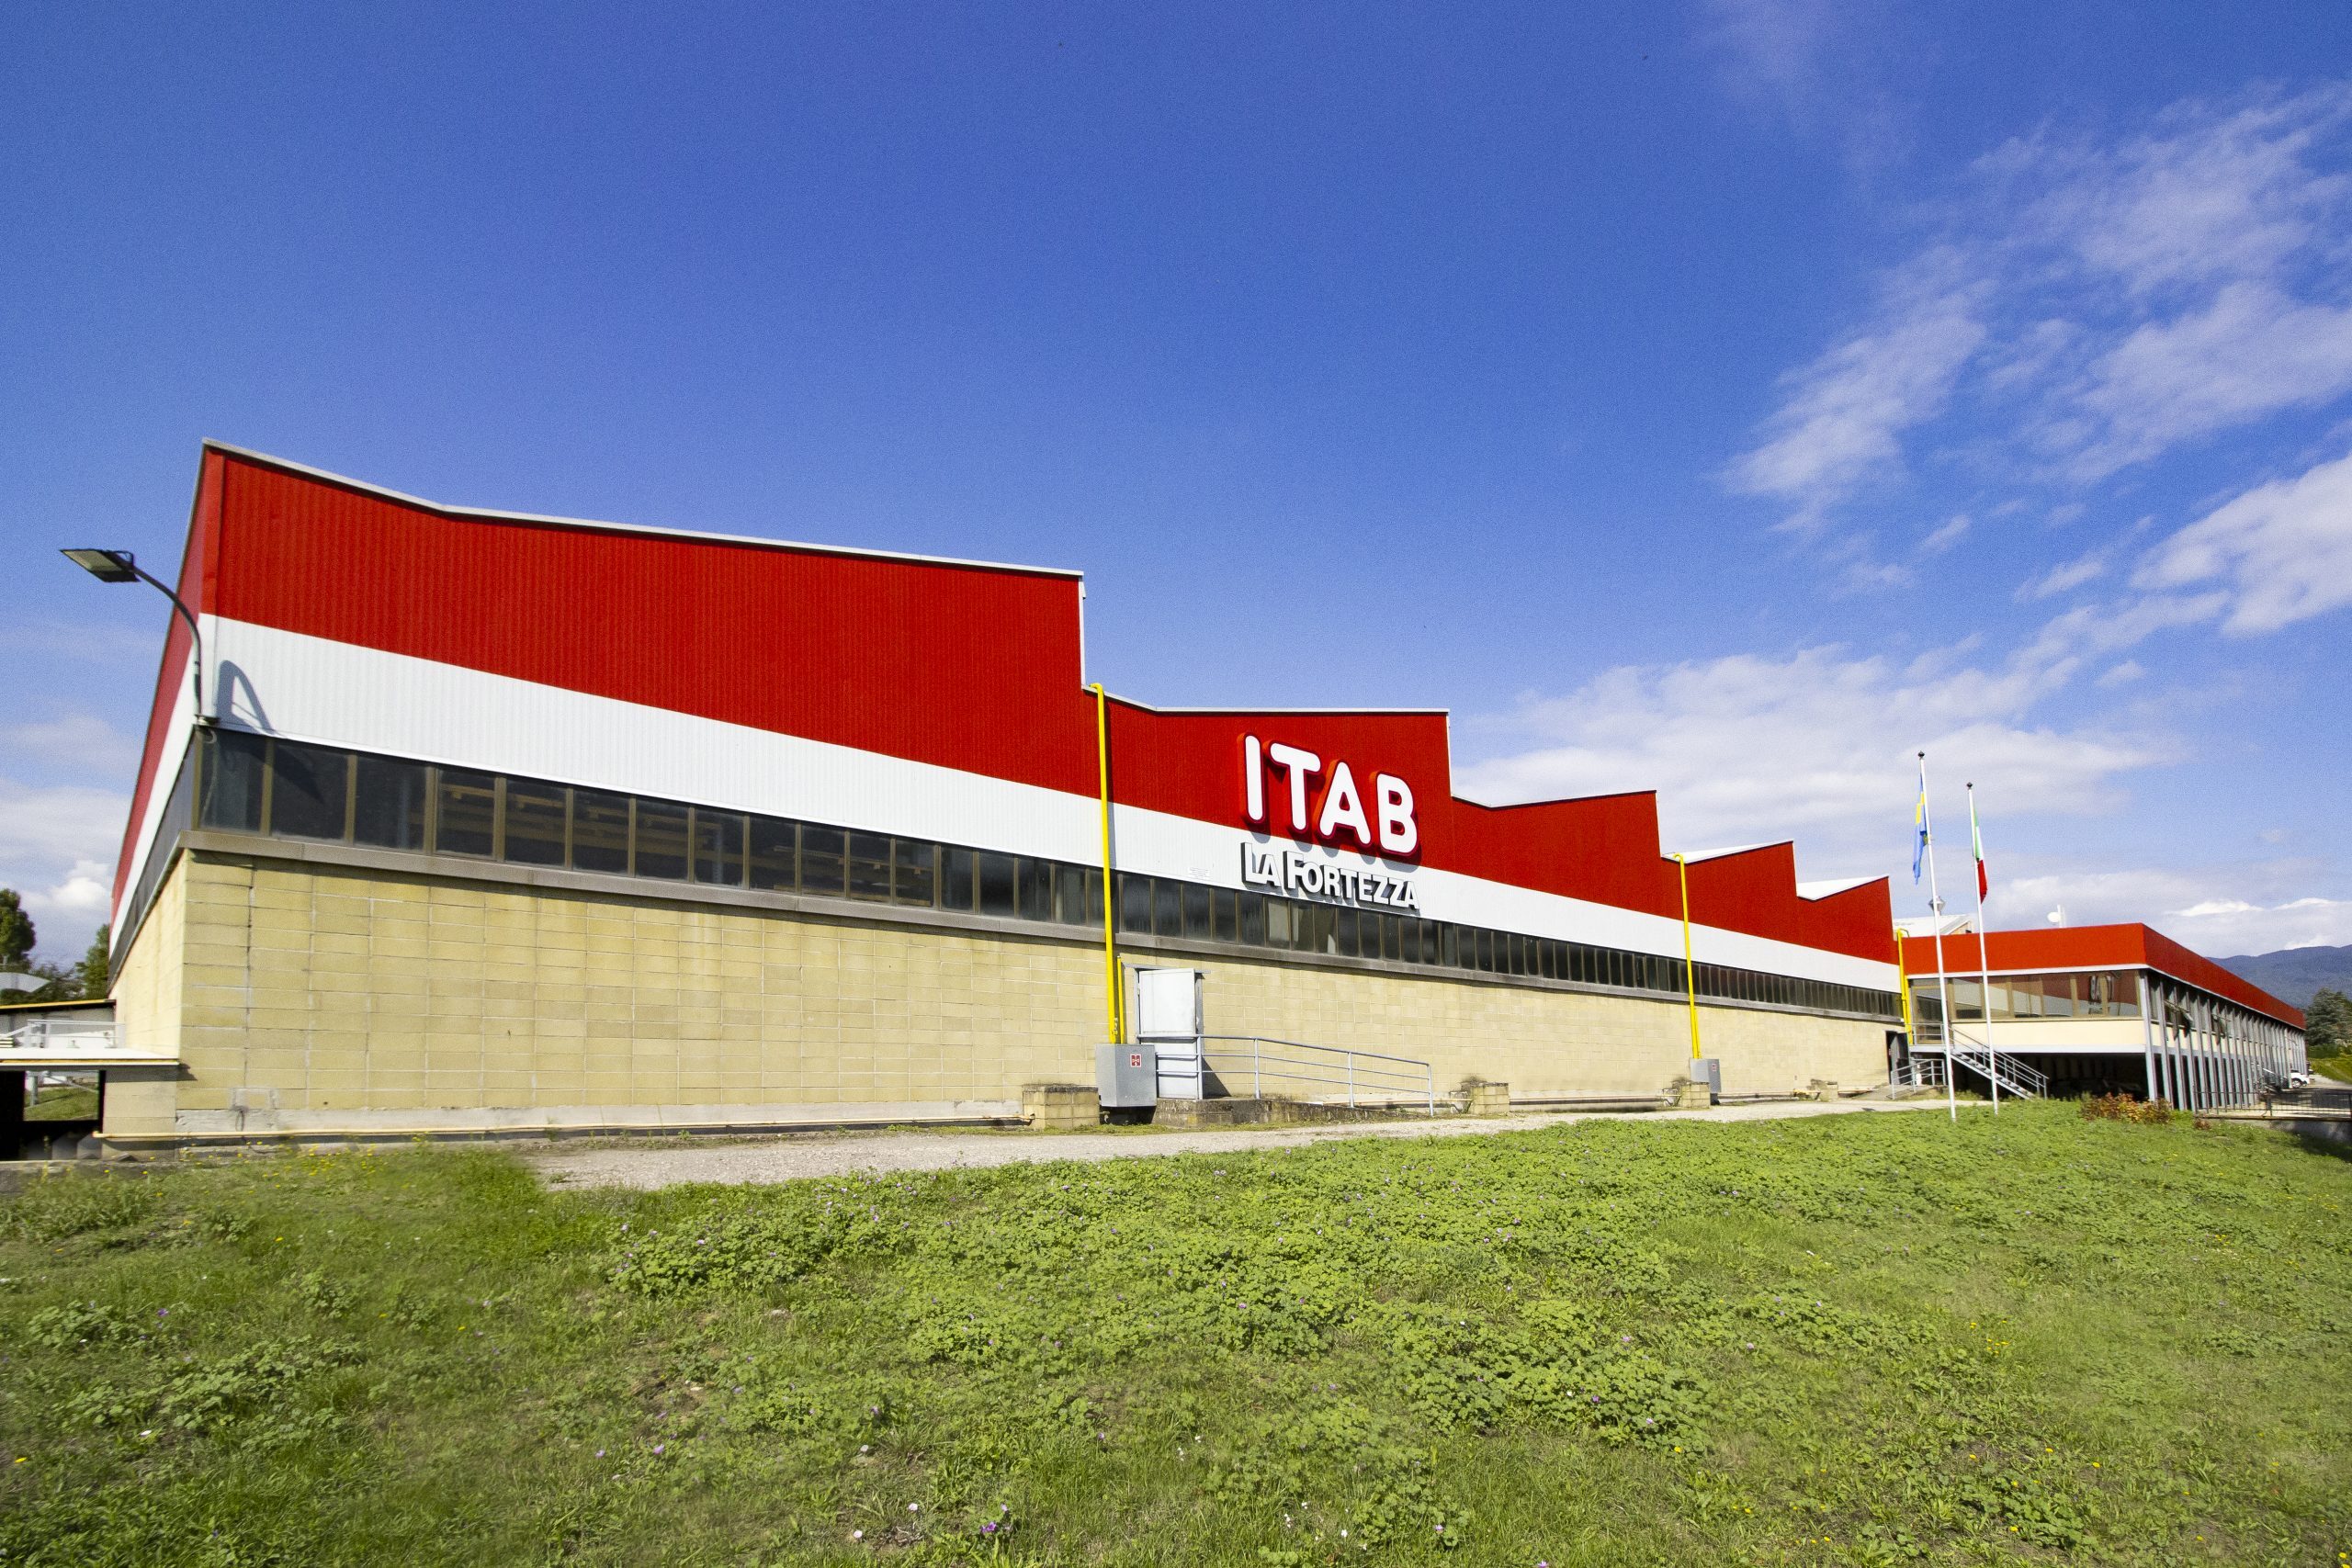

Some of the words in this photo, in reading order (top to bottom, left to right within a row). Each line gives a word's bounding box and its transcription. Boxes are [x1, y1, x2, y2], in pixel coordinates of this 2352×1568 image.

[1238, 732, 1419, 857] ITAB
[1241, 842, 1283, 887] LA
[1283, 851, 1421, 909] FORTEZZA
